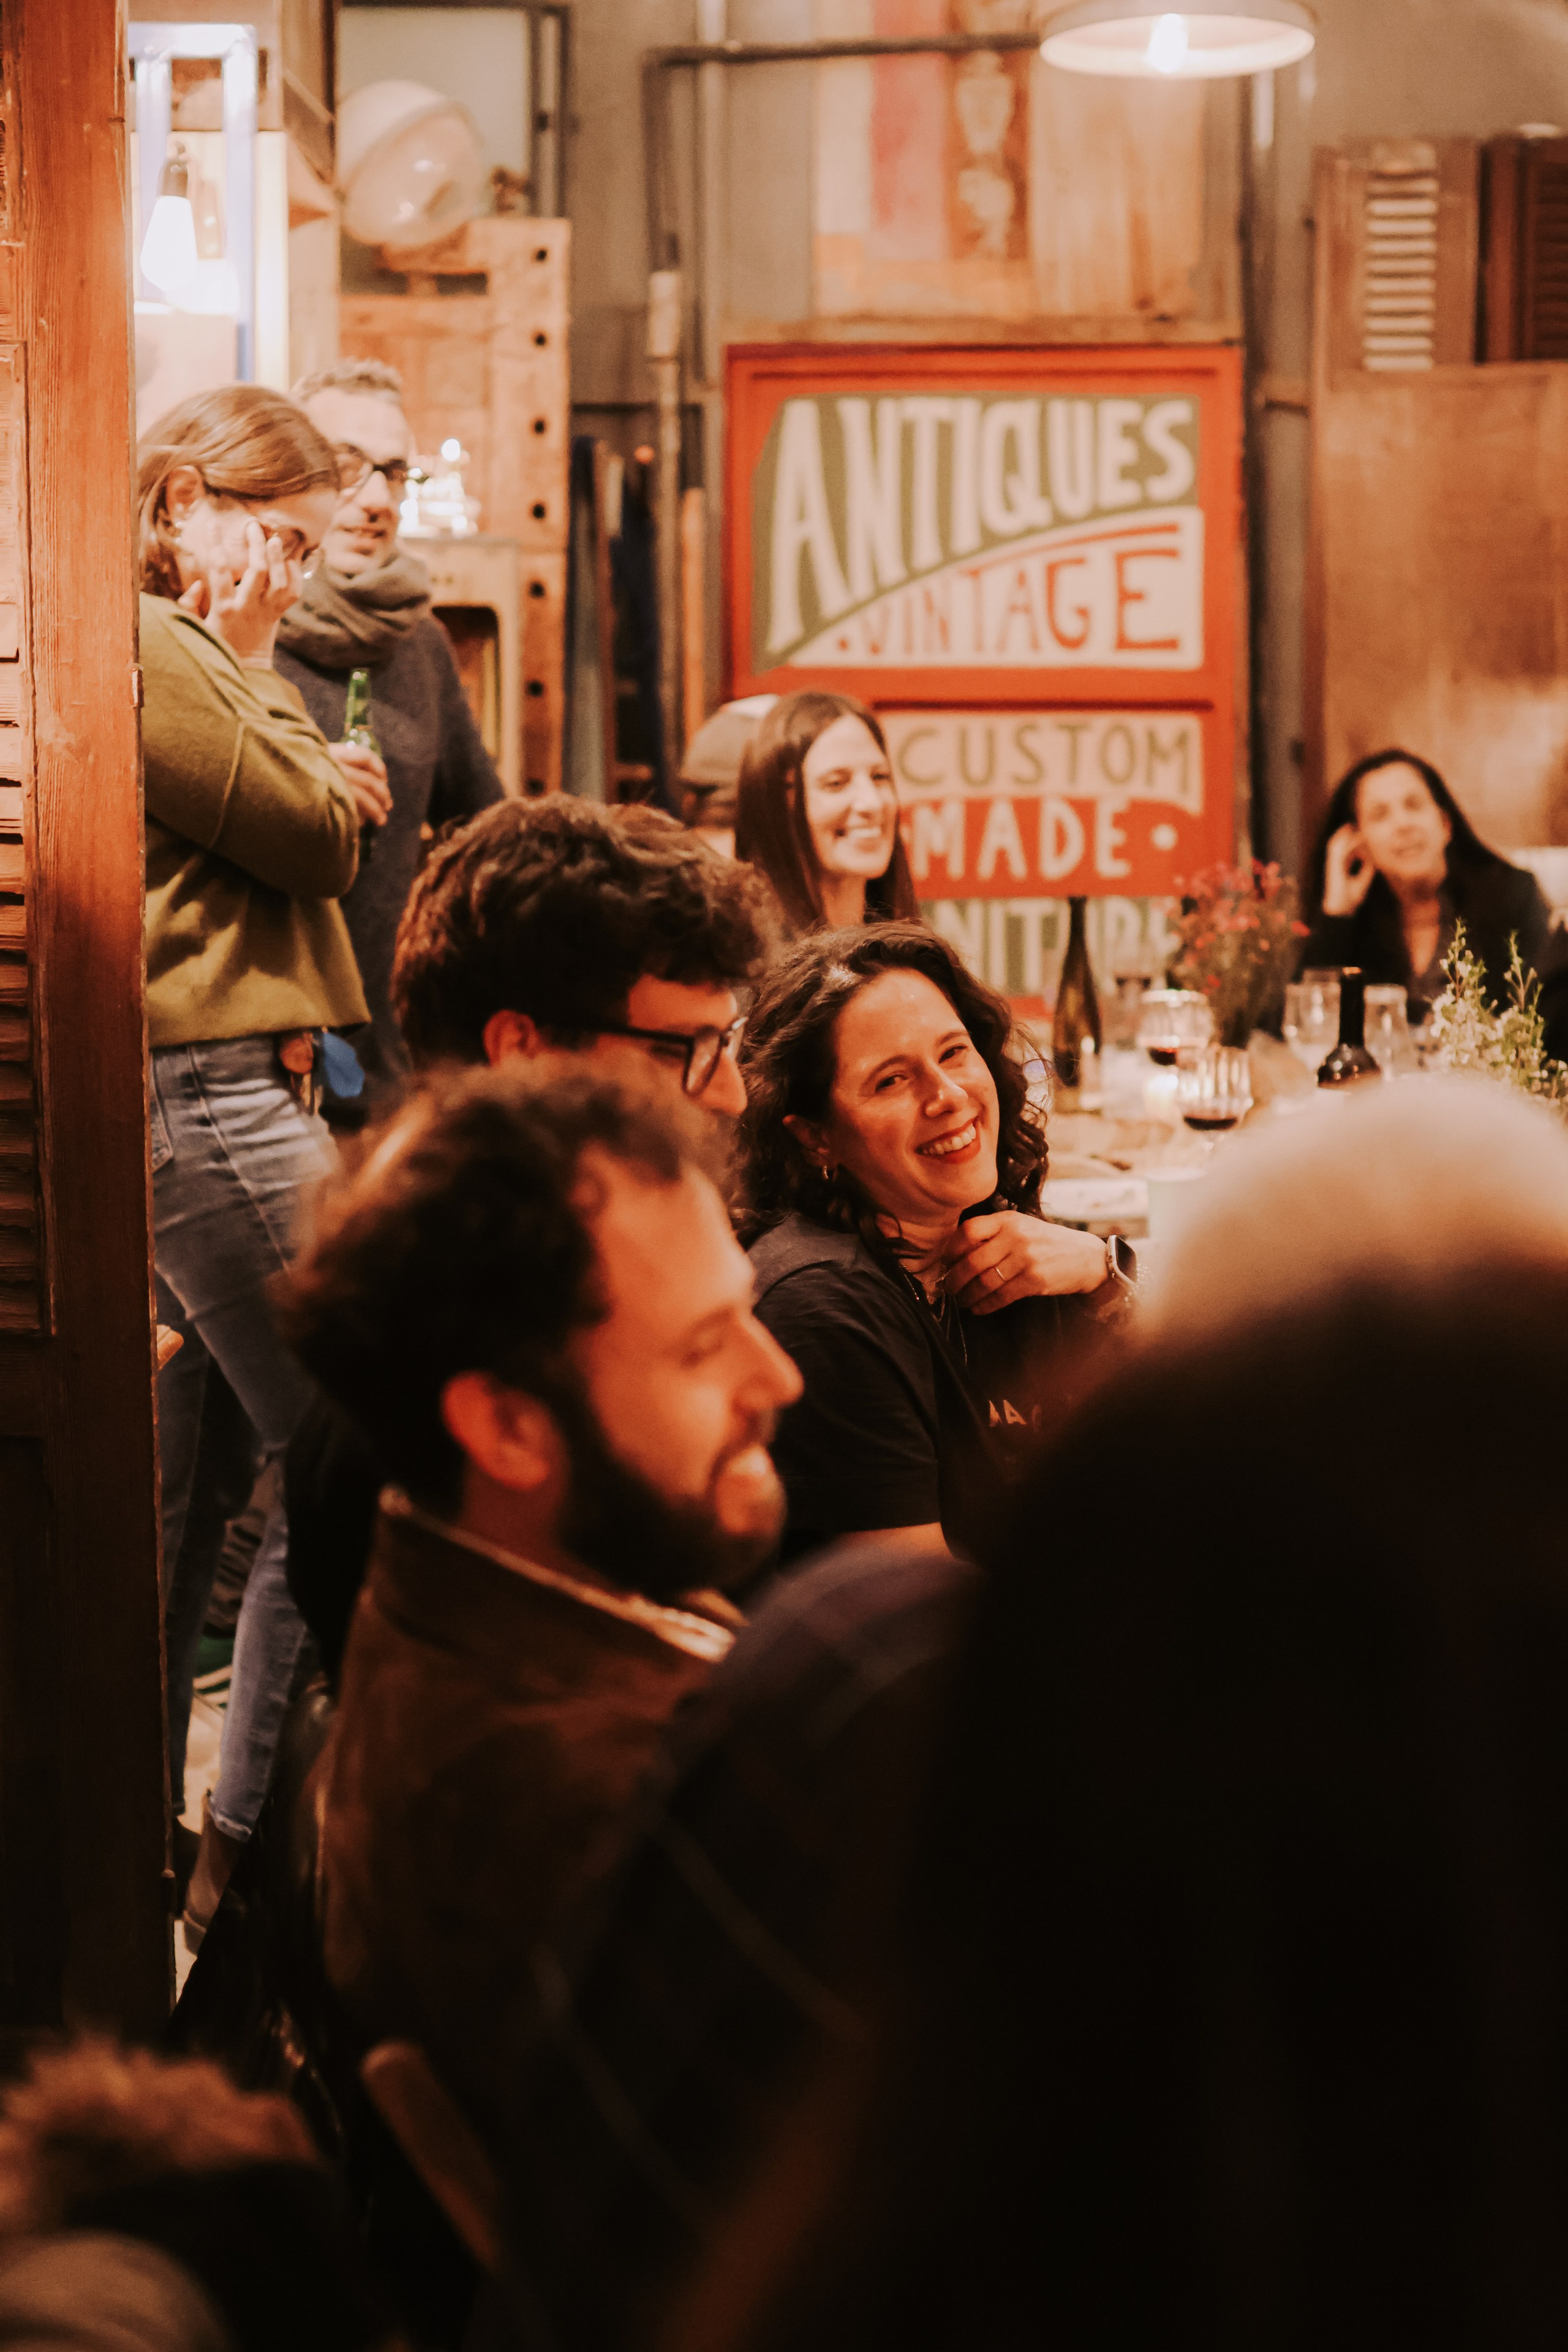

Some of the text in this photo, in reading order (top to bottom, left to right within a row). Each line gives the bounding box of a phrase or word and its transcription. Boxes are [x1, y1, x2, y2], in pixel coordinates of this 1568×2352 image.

[766, 398, 1196, 655] ANTIQUES
[859, 522, 1180, 655] VINTAGE
[897, 720, 1191, 794] CUSTOM
[911, 798, 1132, 880] MADE
